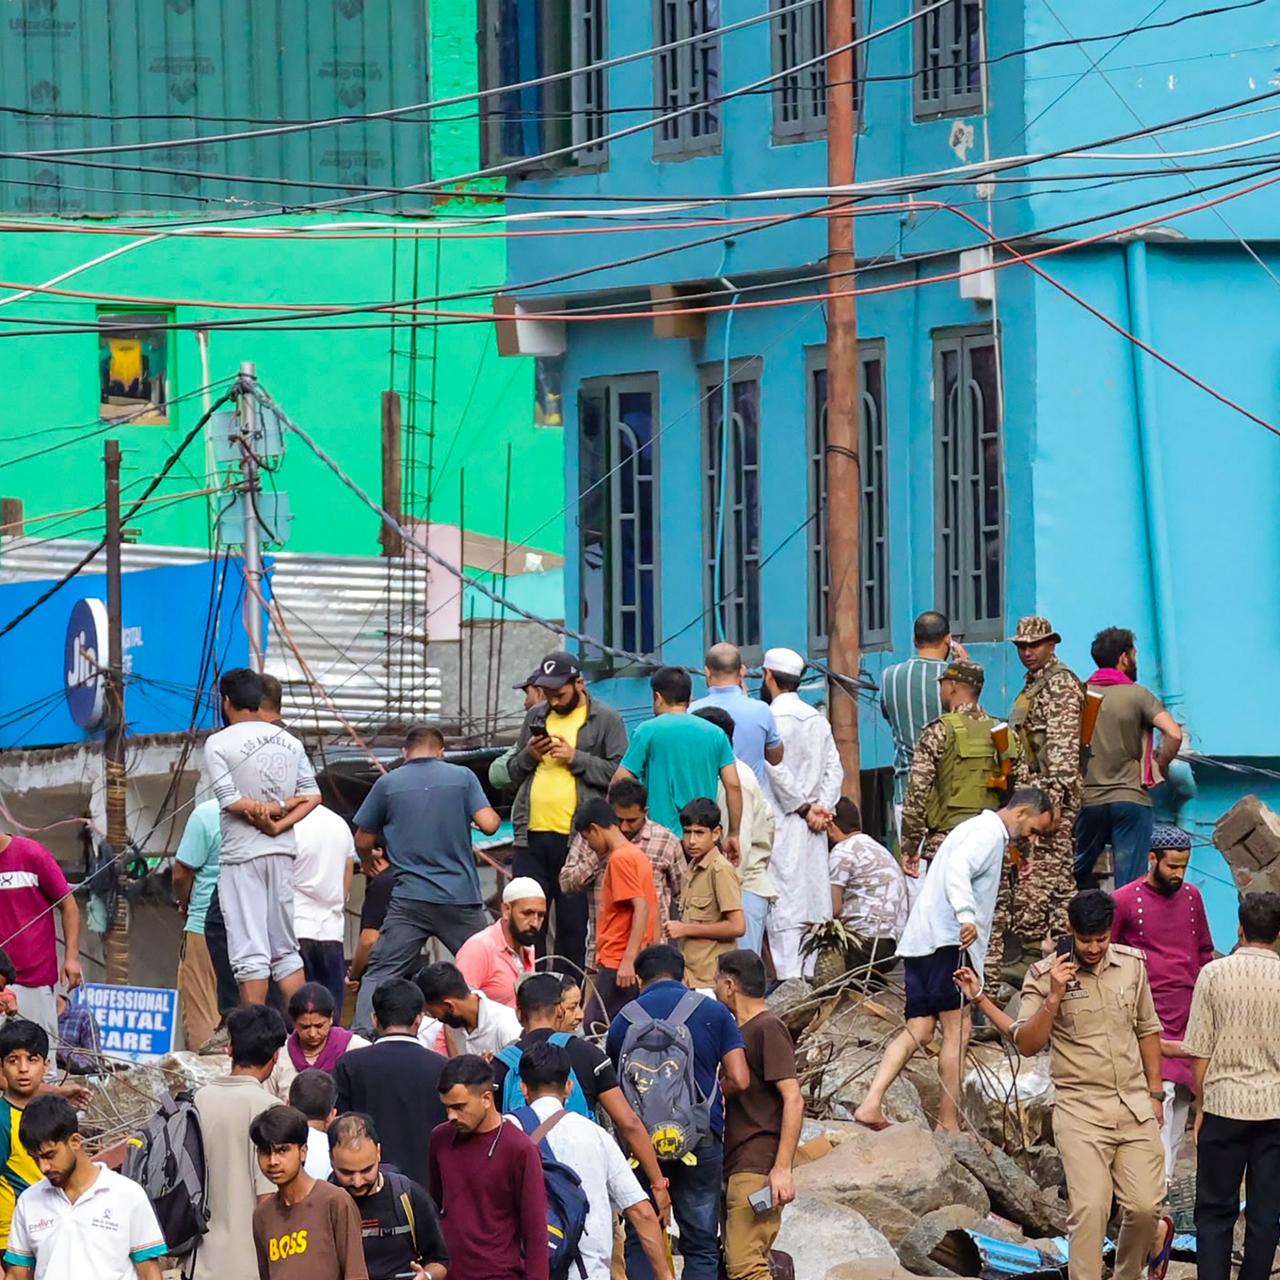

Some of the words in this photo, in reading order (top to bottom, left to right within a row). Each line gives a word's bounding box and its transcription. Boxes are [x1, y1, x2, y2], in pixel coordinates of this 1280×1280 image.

[67, 630, 97, 688] Jio
[257, 752, 287, 783] 23
[78, 987, 169, 1012] PROFESSIONAL
[89, 1007, 167, 1031] ENTAL
[269, 1230, 308, 1261] BOSS
